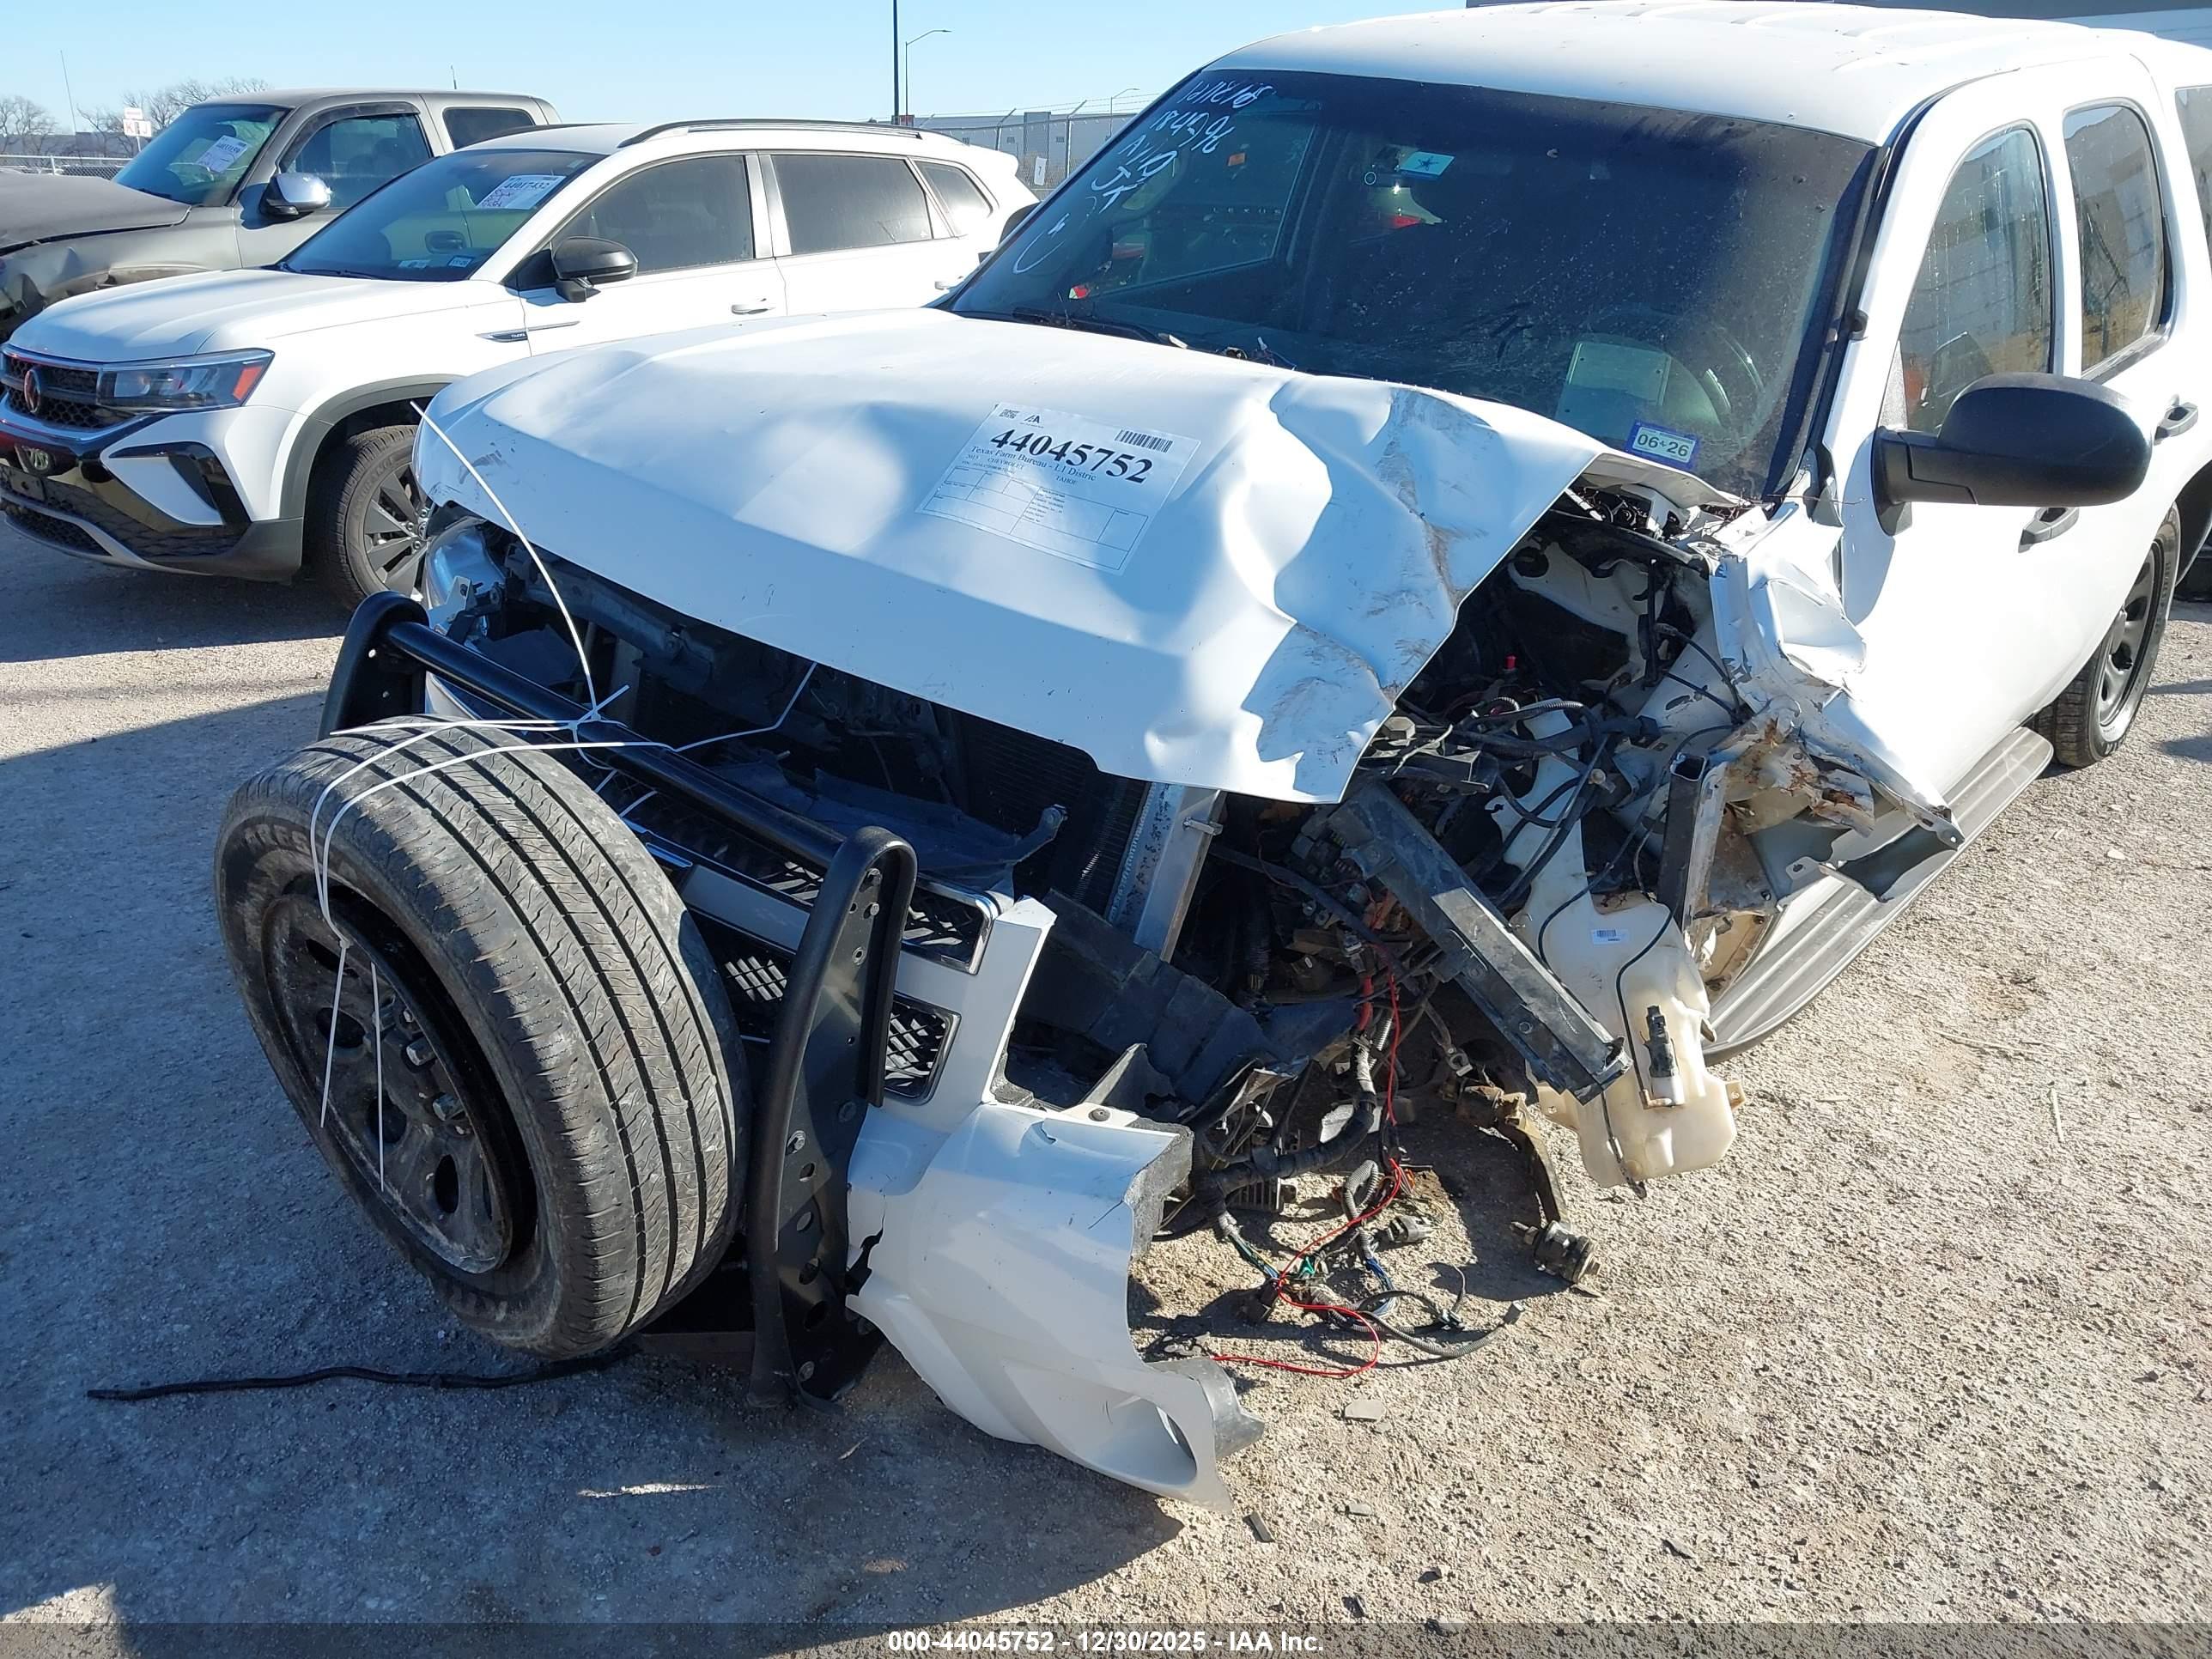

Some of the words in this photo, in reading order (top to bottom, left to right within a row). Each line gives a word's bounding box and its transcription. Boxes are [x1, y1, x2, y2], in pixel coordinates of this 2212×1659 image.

[990, 428, 1153, 484] 44045752
[1637, 434, 1660, 448] 06
[1667, 441, 1690, 457] 26
[970, 446, 994, 456] Texas
[994, 449, 1017, 459] Farm
[1018, 454, 1048, 468] Bureau
[1067, 467, 1097, 482] Distric
